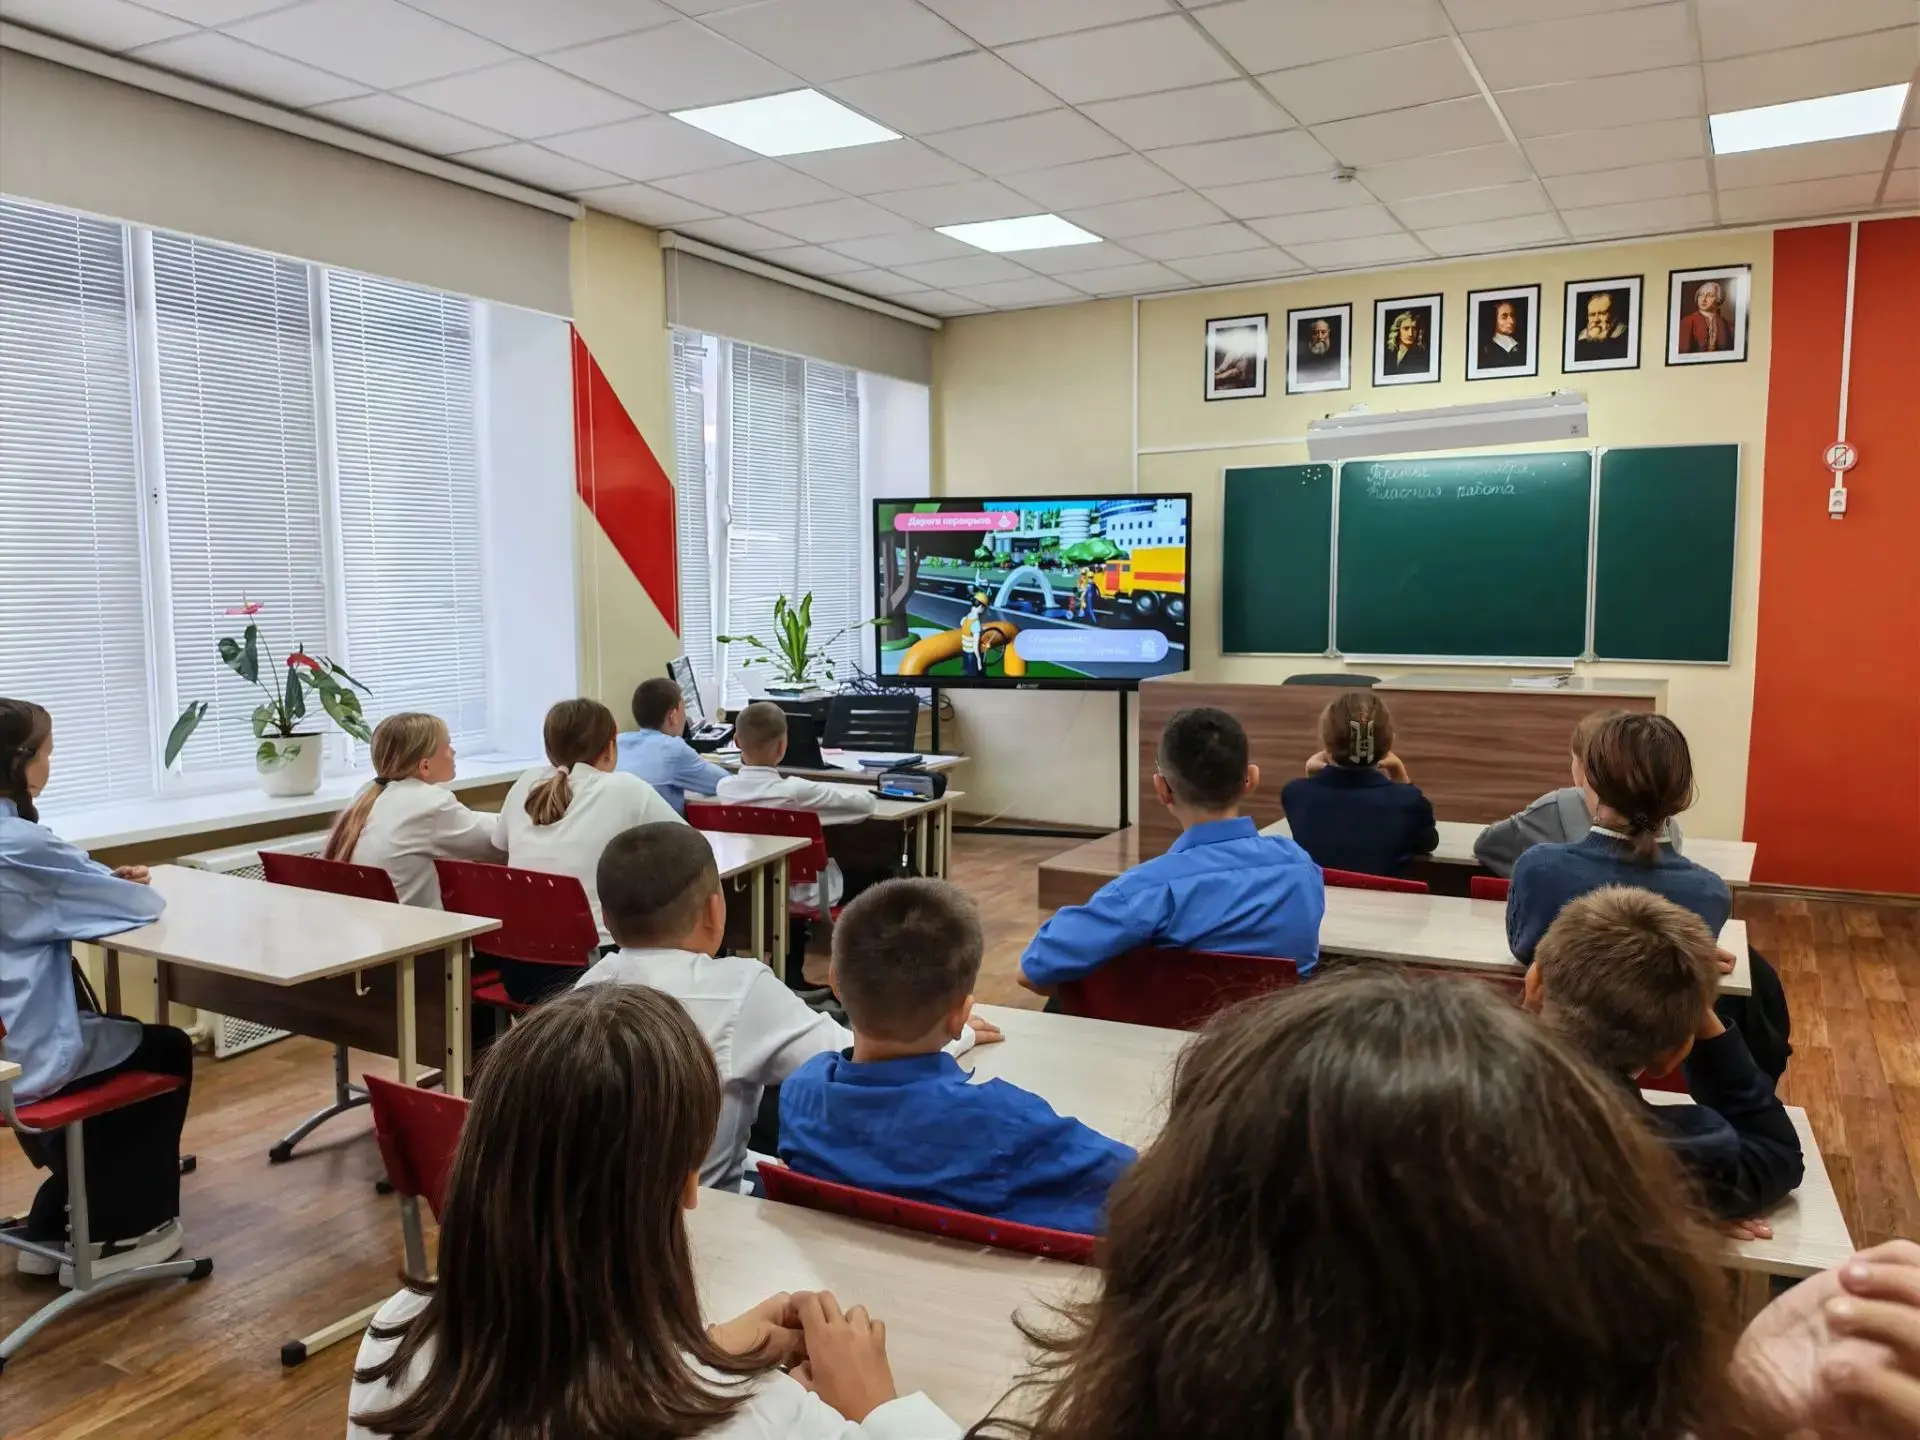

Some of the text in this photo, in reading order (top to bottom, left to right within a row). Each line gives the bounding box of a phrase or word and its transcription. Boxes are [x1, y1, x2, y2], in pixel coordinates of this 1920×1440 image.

[1457, 481, 1516, 499] работа
[908, 516, 992, 527] Дорога перекрыта
